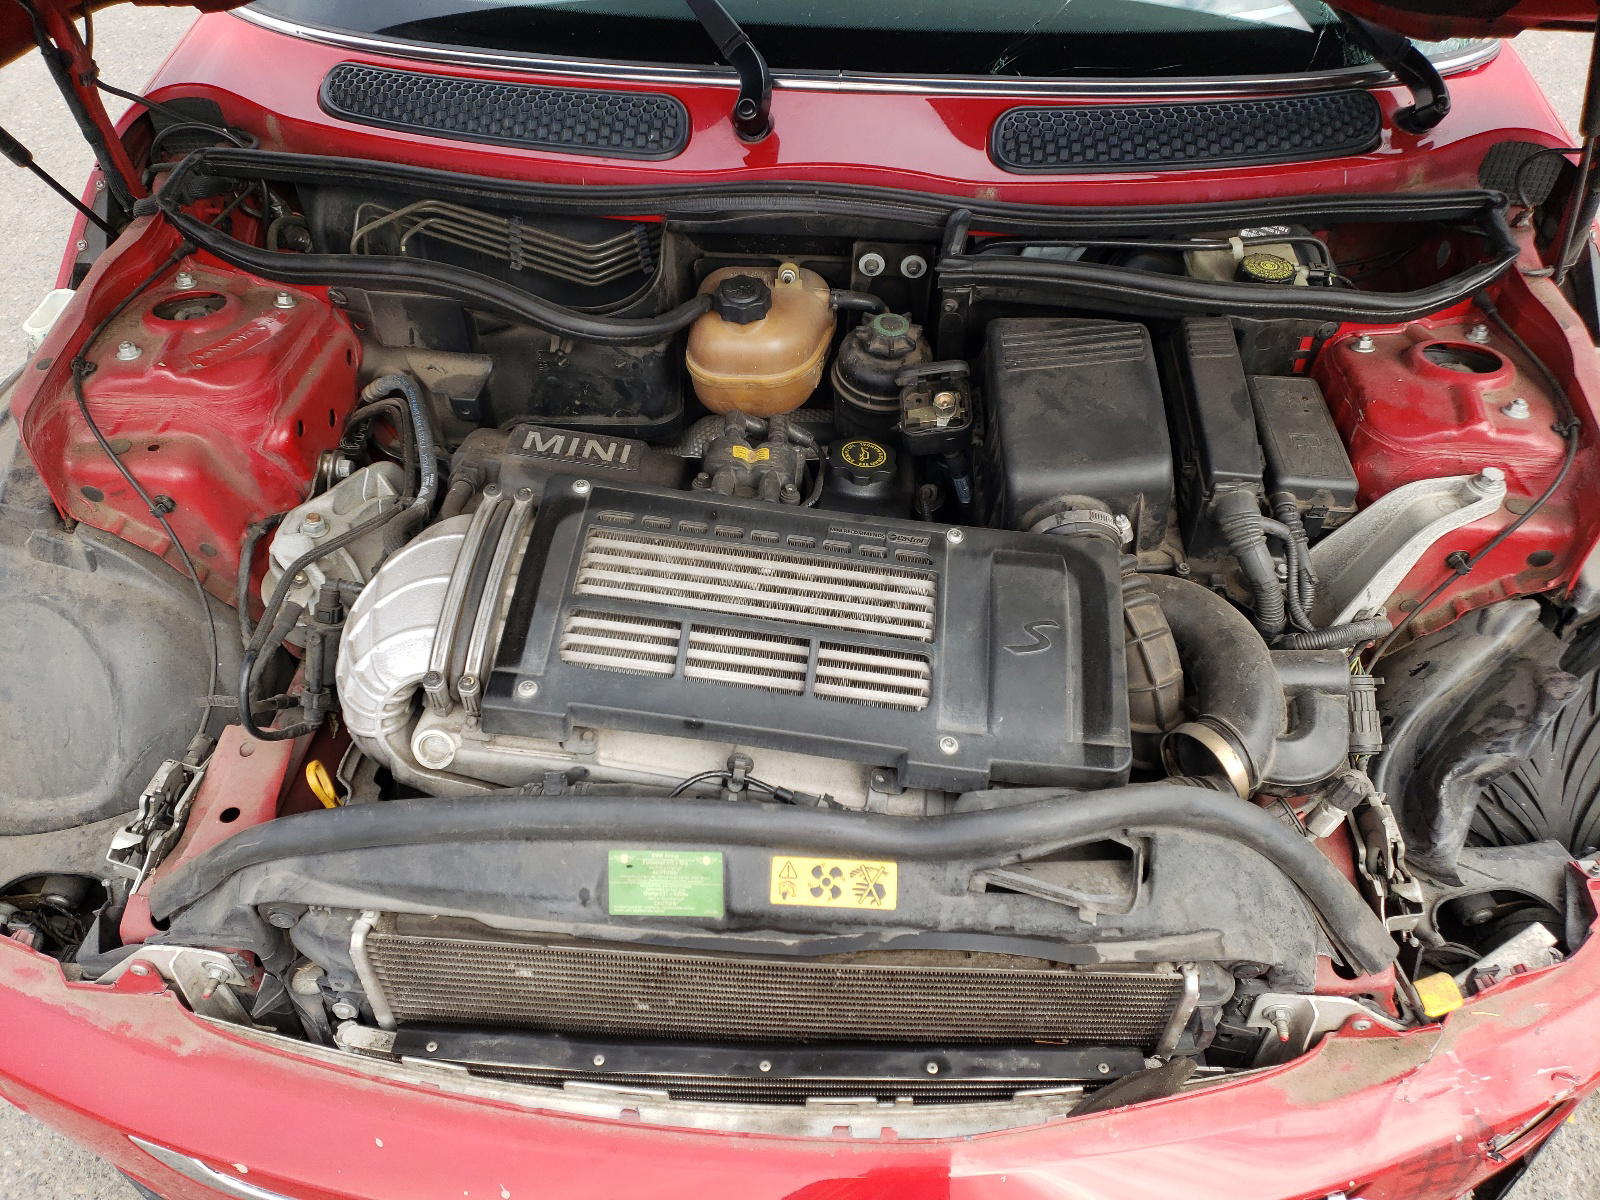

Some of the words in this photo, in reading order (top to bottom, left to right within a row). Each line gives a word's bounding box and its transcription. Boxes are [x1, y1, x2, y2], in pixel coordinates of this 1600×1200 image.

[522, 430, 631, 464] MINI
[897, 534, 924, 544] Castrol
[1003, 619, 1060, 656] S
